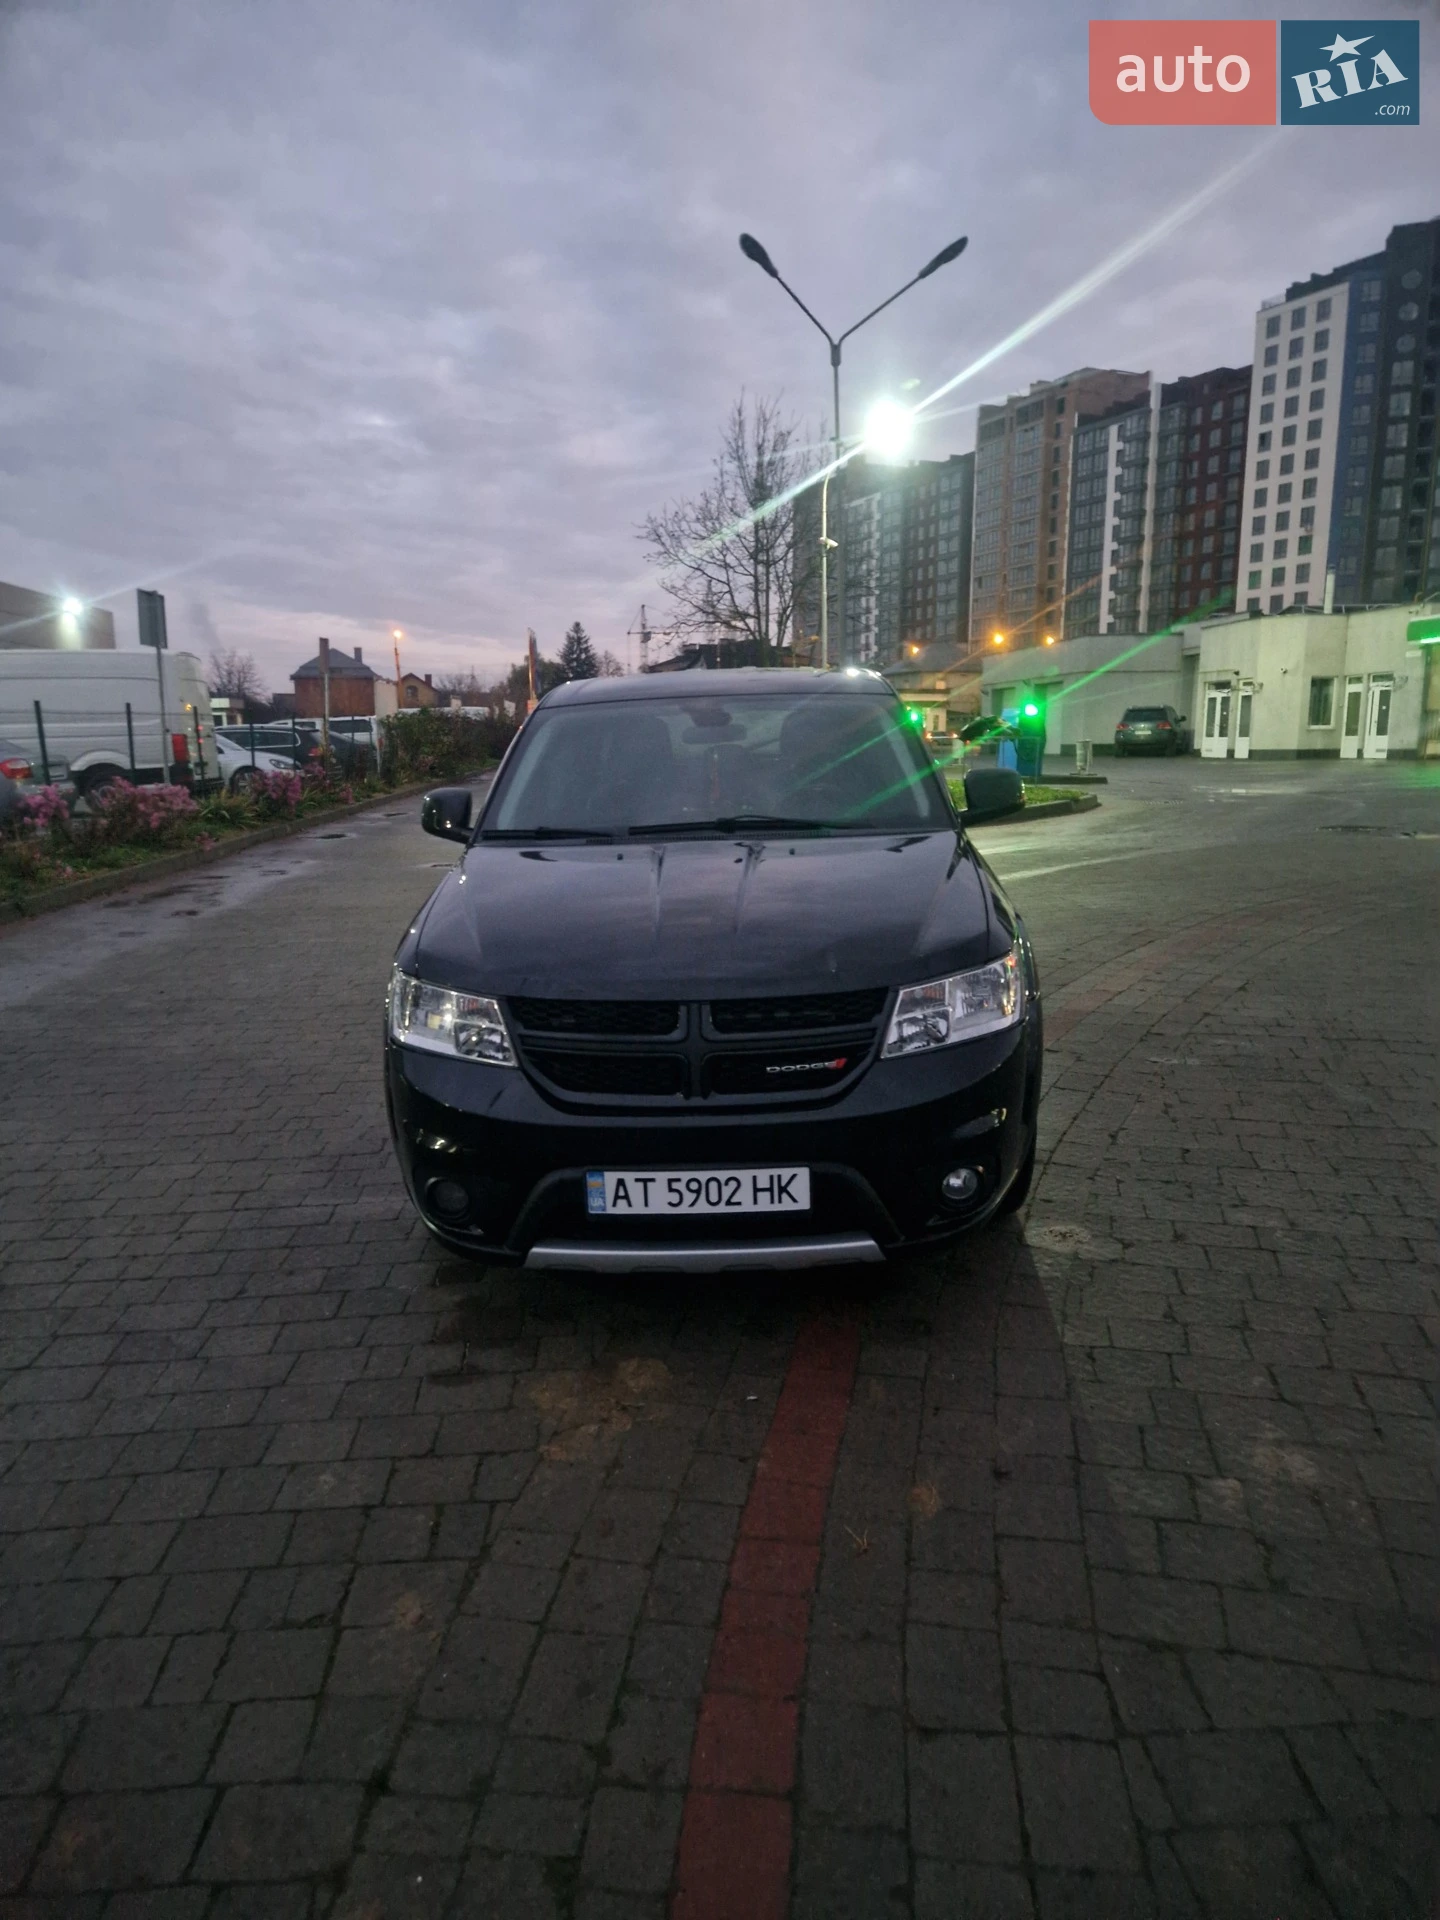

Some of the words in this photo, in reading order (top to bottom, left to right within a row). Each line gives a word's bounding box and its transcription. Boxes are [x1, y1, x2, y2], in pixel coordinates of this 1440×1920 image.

[766, 1060, 837, 1073] DODGE
[611, 1177, 656, 1208] AT
[666, 1176, 743, 1208] 5902
[752, 1173, 799, 1206] HK
